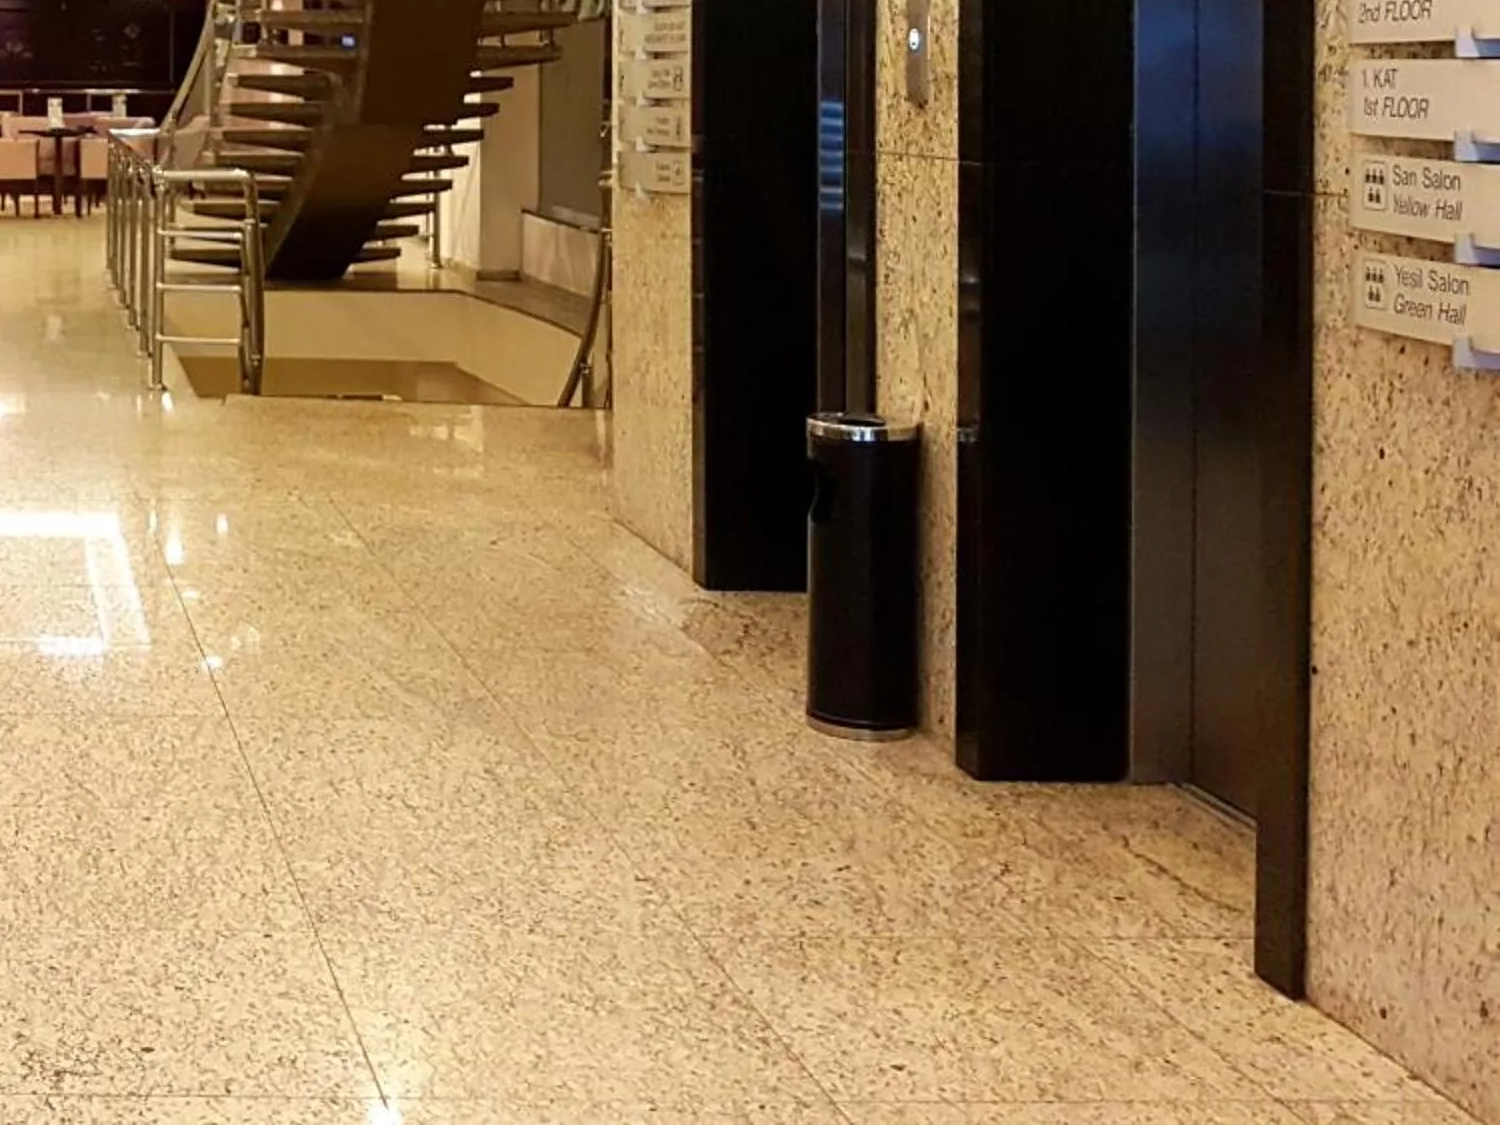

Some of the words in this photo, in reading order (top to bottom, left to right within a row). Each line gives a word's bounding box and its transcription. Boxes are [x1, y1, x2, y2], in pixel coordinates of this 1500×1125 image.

[1358, 1, 1380, 23] 2nd
[1373, 68, 1397, 88] KAT
[1382, 96, 1429, 118] FLOOR
[1421, 166, 1461, 191] Salon
[1393, 194, 1430, 217] Yellow
[1436, 198, 1463, 221] Hall
[1428, 269, 1469, 295] Salon
[1394, 293, 1433, 318] Green
[1438, 301, 1467, 326] Hall
